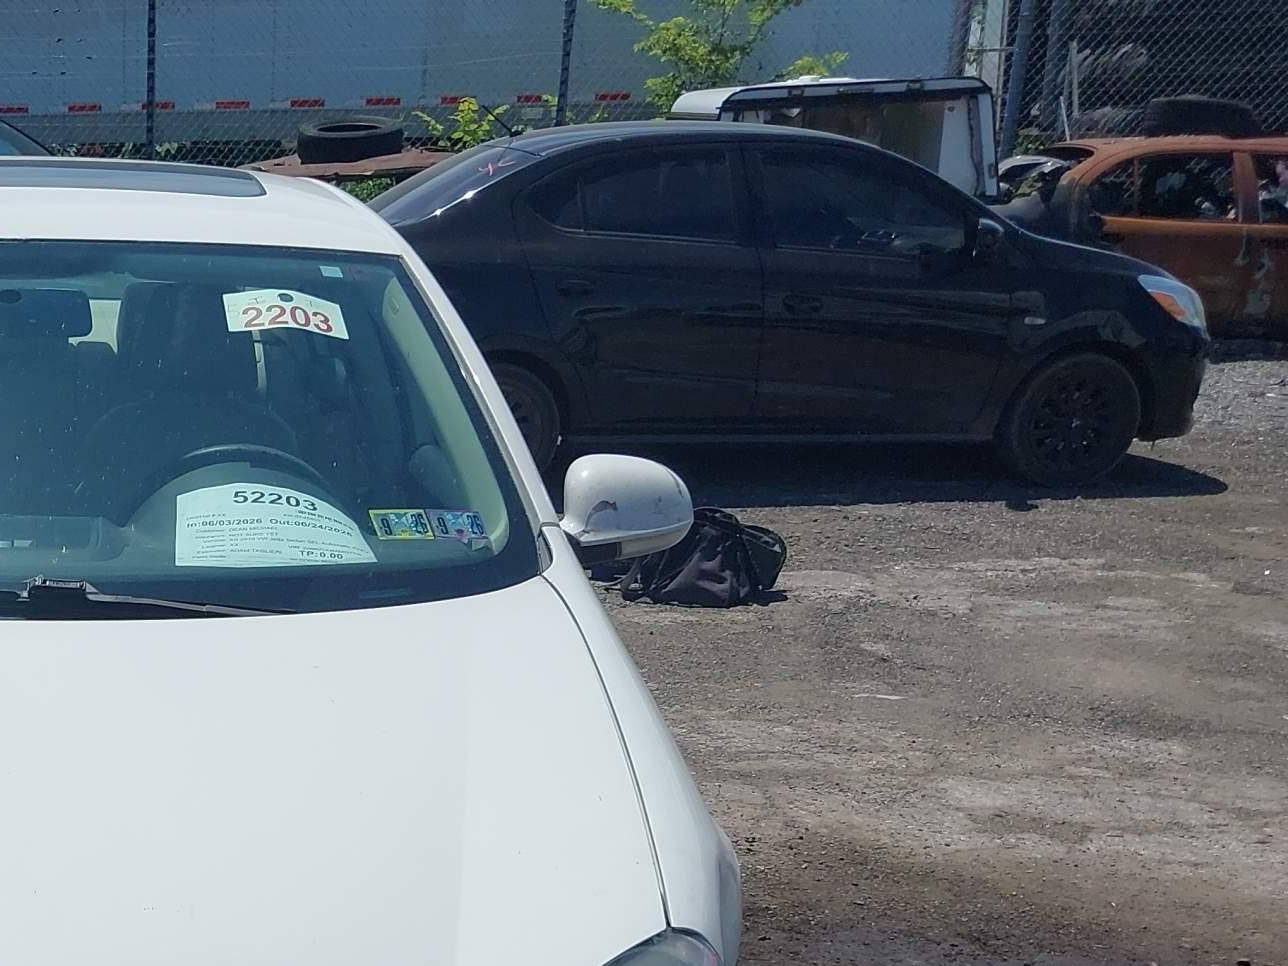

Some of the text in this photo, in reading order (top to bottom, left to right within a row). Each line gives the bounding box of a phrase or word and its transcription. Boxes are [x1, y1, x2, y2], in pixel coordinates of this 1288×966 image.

[242, 305, 334, 334] 2203
[233, 491, 318, 512] 52203
[299, 550, 343, 560] TP:0.00
